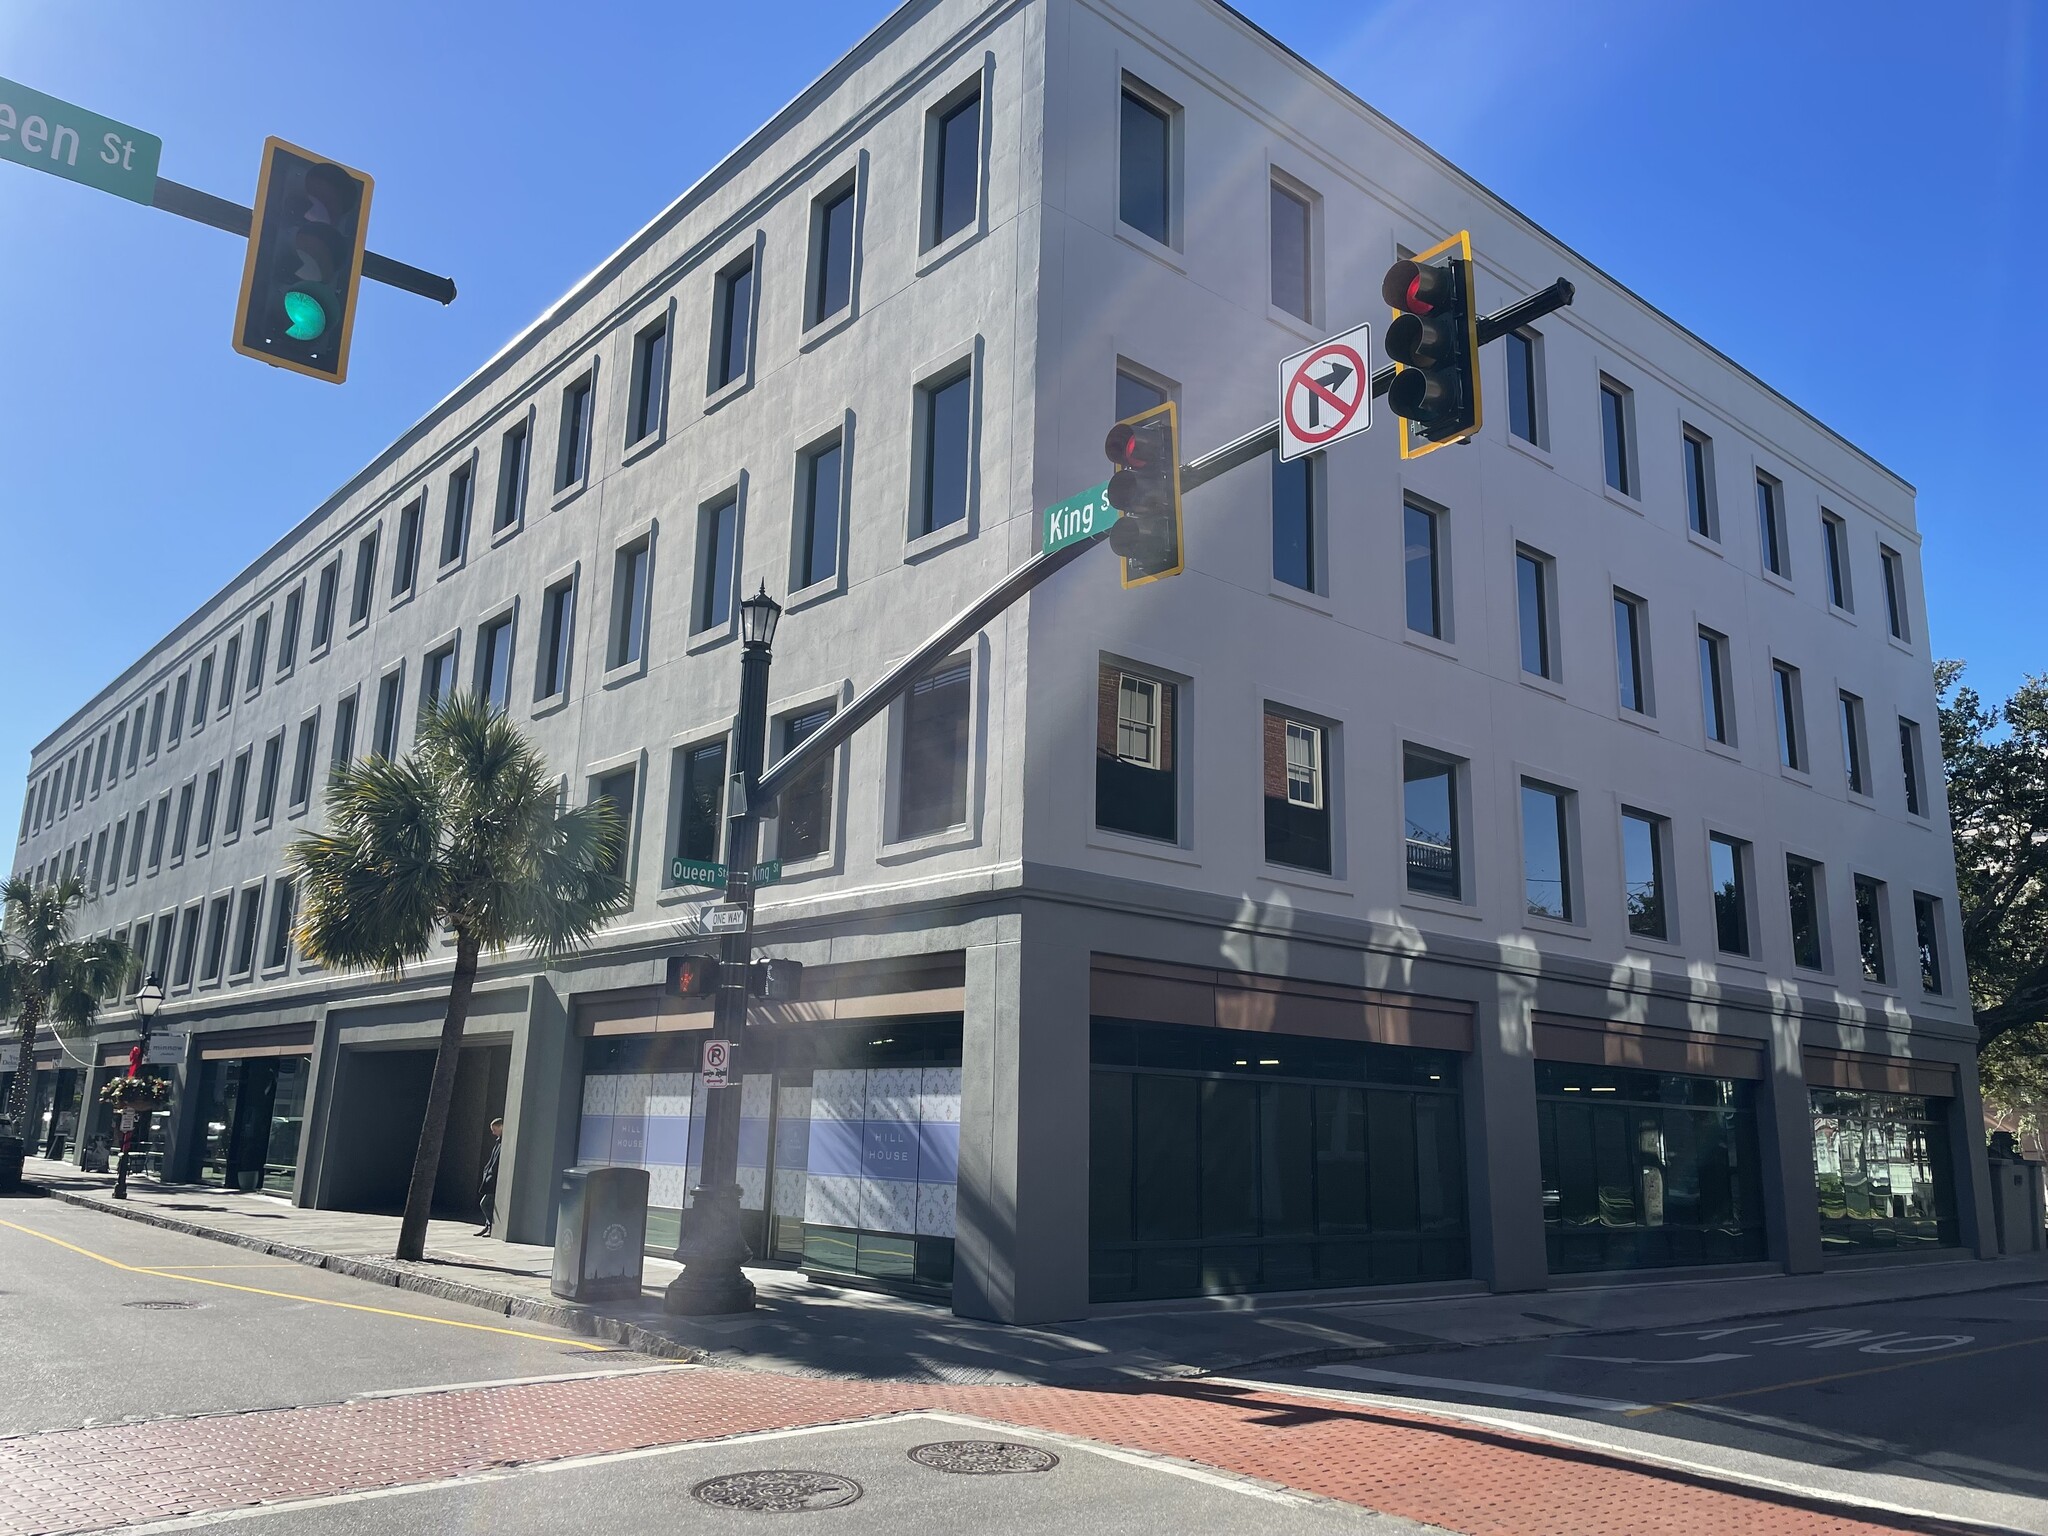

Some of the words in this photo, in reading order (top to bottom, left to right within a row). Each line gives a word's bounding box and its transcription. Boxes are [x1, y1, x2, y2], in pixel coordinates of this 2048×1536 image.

[100, 132, 136, 171] St
[1049, 502, 1094, 544] King
[1100, 489, 1110, 512] S
[673, 861, 715, 883] Queen
[717, 867, 727, 878] St
[752, 866, 770, 883] King
[773, 862, 779, 873] St
[713, 913, 726, 925] ONE
[727, 911, 742, 924] WAY
[622, 1125, 641, 1133] HILL
[617, 1139, 644, 1148] HOUSE
[875, 1133, 904, 1143] HILL
[869, 1150, 908, 1161] HOUSE
